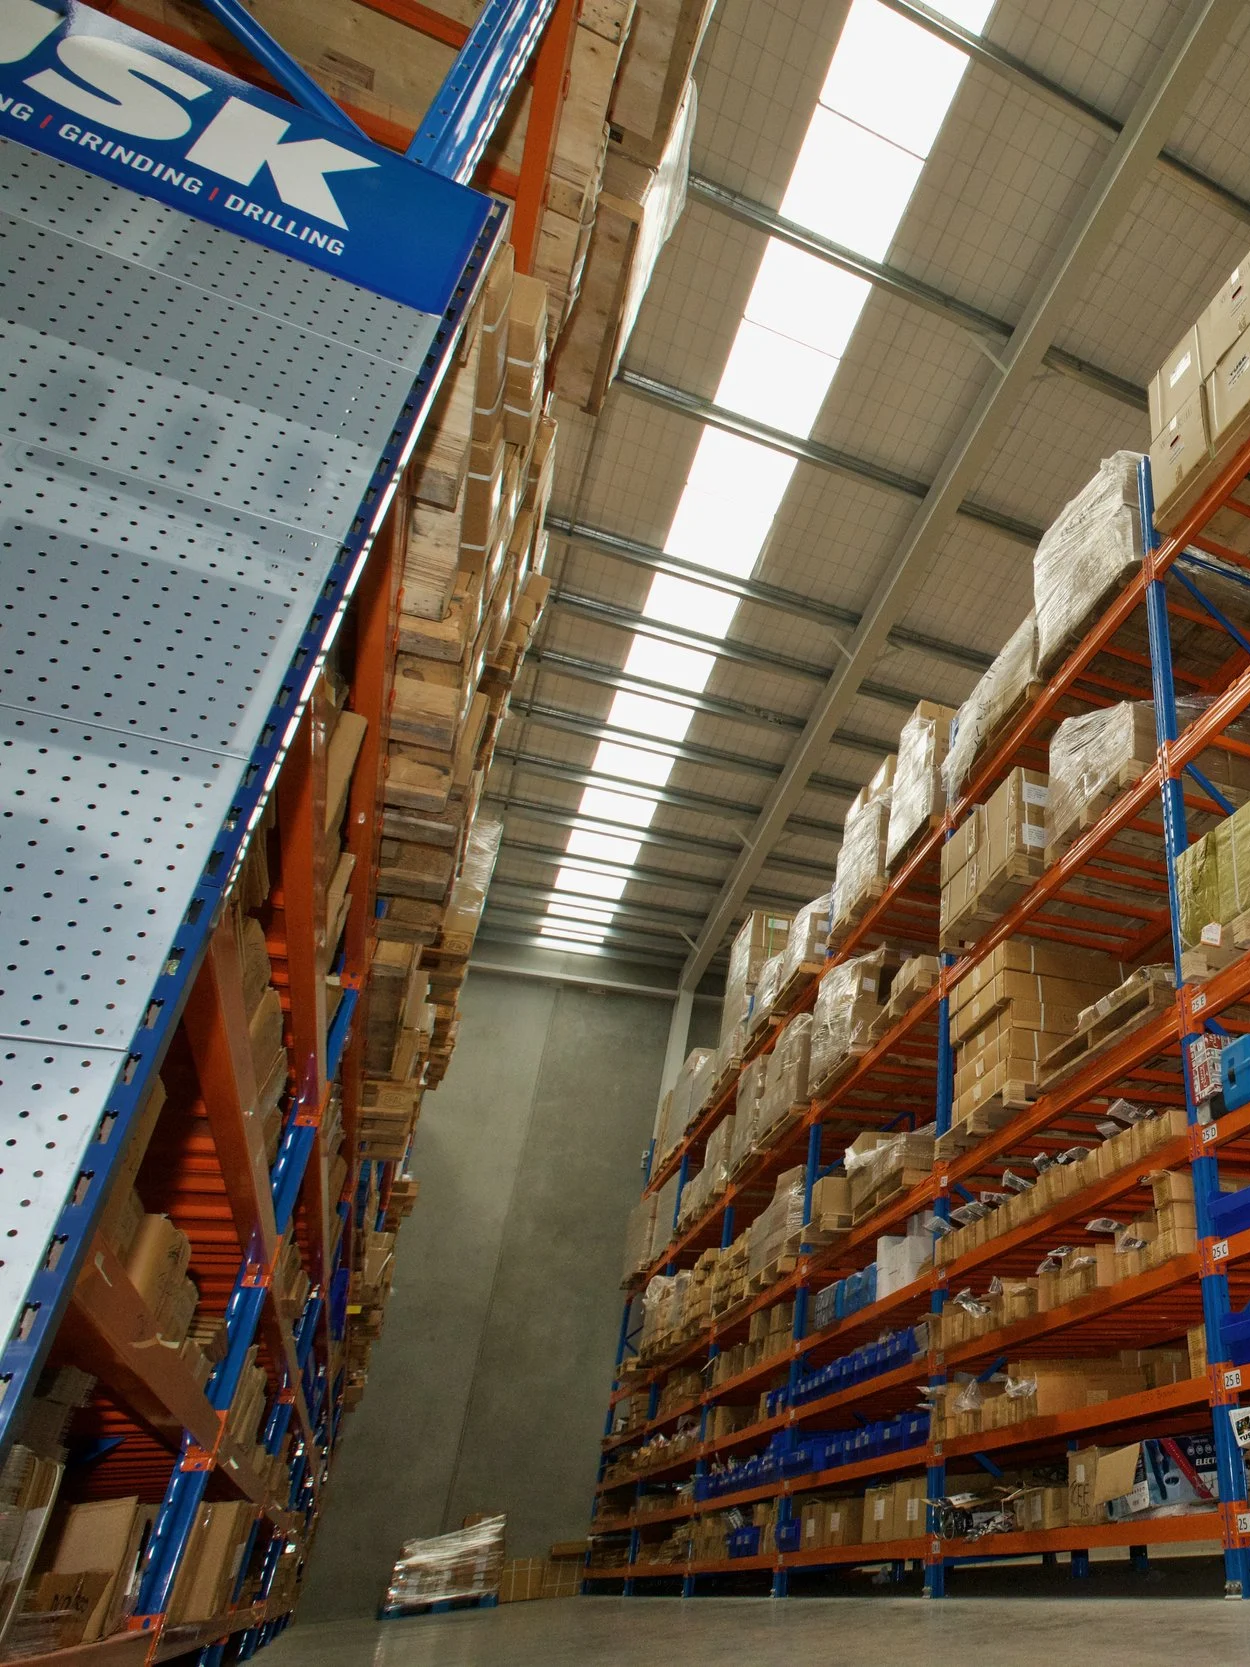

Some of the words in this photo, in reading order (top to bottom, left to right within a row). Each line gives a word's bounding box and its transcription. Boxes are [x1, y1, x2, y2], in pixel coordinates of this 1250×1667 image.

[58, 123, 204, 195] GRINDING
[223, 193, 346, 257] DRILLING
[1201, 1130, 1210, 1142] 25
[1210, 1127, 1216, 1137] D
[1212, 1246, 1221, 1259] 25
[1221, 1243, 1227, 1255] C
[1225, 1374, 1234, 1387] 25
[1235, 1373, 1241, 1385] B
[1195, 1457, 1217, 1466] ELECT
[1238, 1517, 1248, 1530] 25
